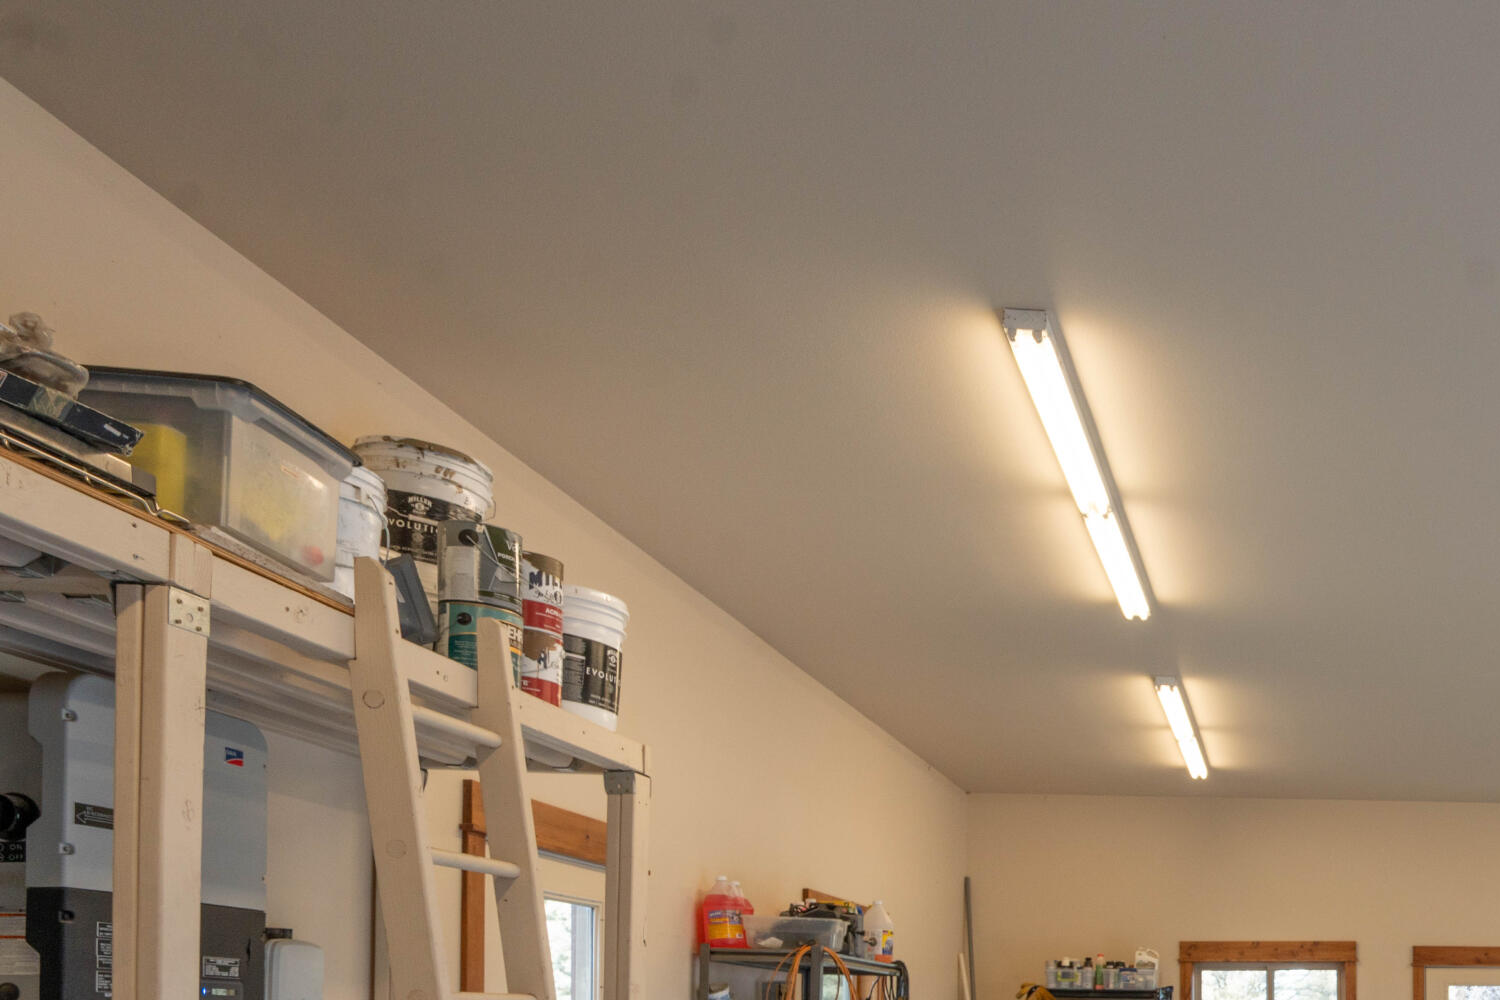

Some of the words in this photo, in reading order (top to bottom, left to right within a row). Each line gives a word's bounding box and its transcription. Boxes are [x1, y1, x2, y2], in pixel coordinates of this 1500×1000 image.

[408, 495, 432, 507] MILLER
[388, 518, 438, 534] VOLUTI
[508, 626, 523, 641] EH
